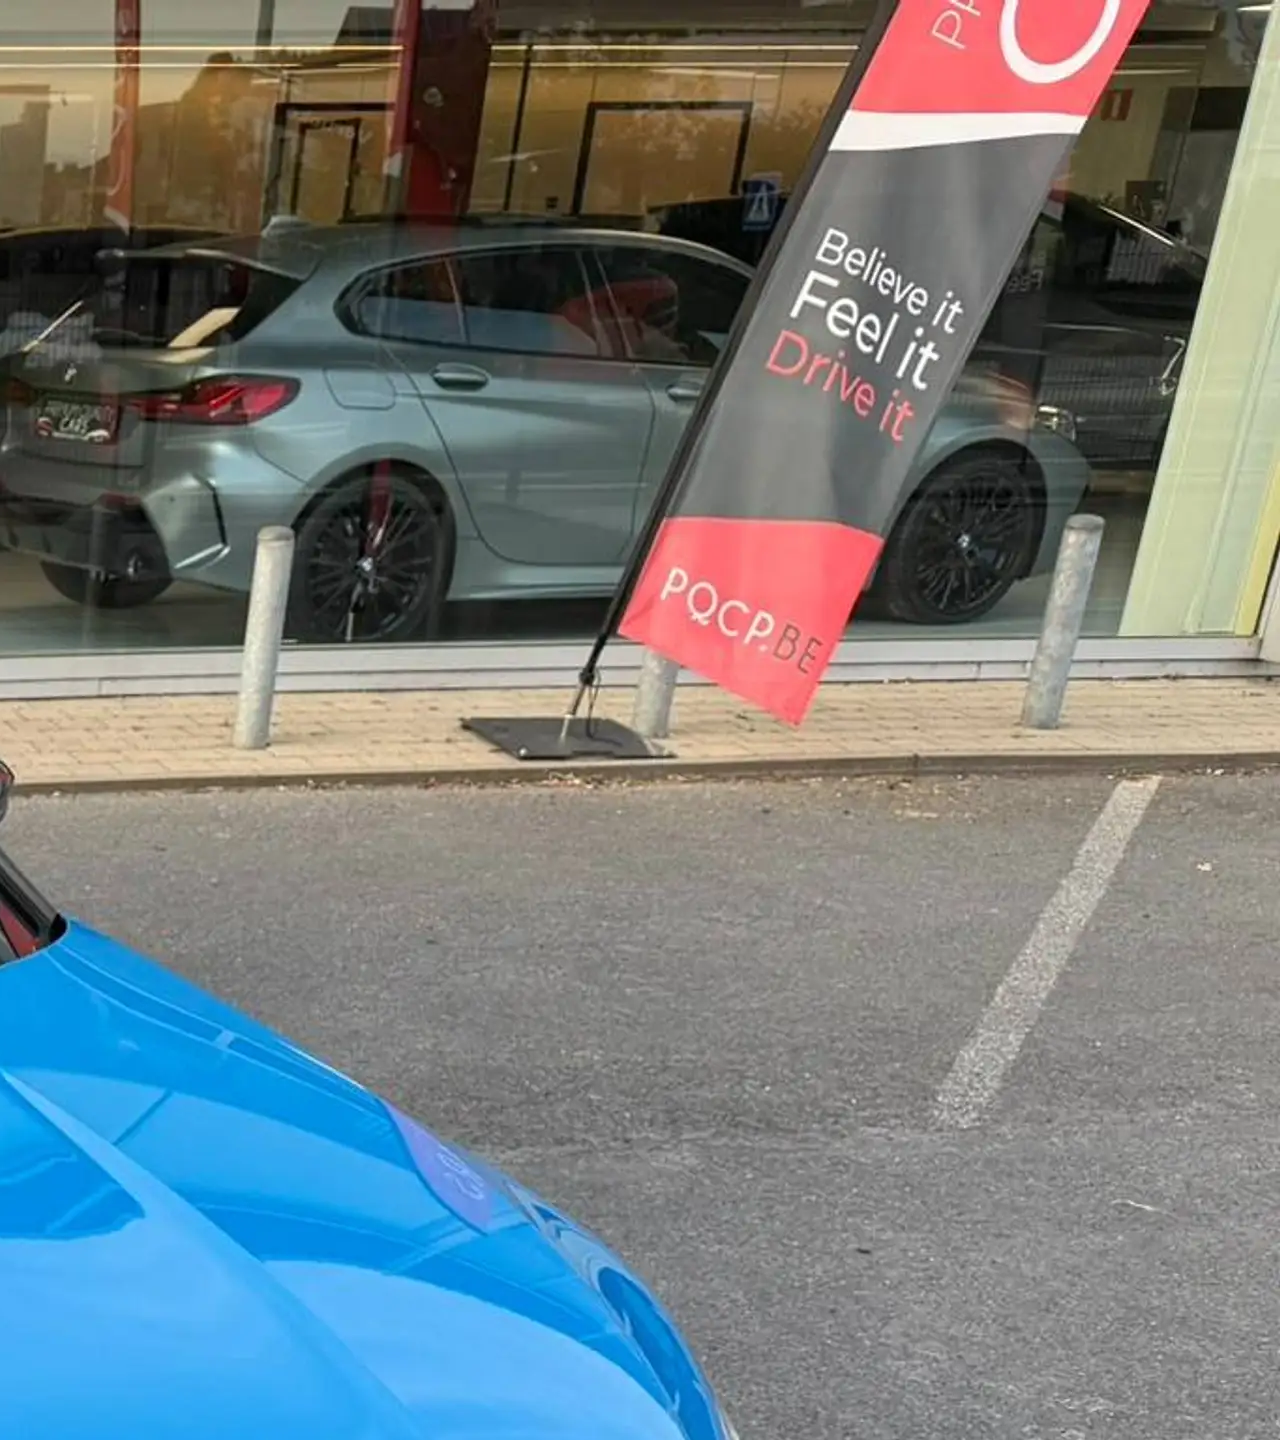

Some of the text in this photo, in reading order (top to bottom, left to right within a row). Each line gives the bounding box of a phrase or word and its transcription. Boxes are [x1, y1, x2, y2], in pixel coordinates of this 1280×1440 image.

[789, 269, 940, 390] Feel it
[815, 227, 964, 335] Believe it
[765, 329, 915, 442] Drive it
[660, 566, 824, 675] PQCP.BE
